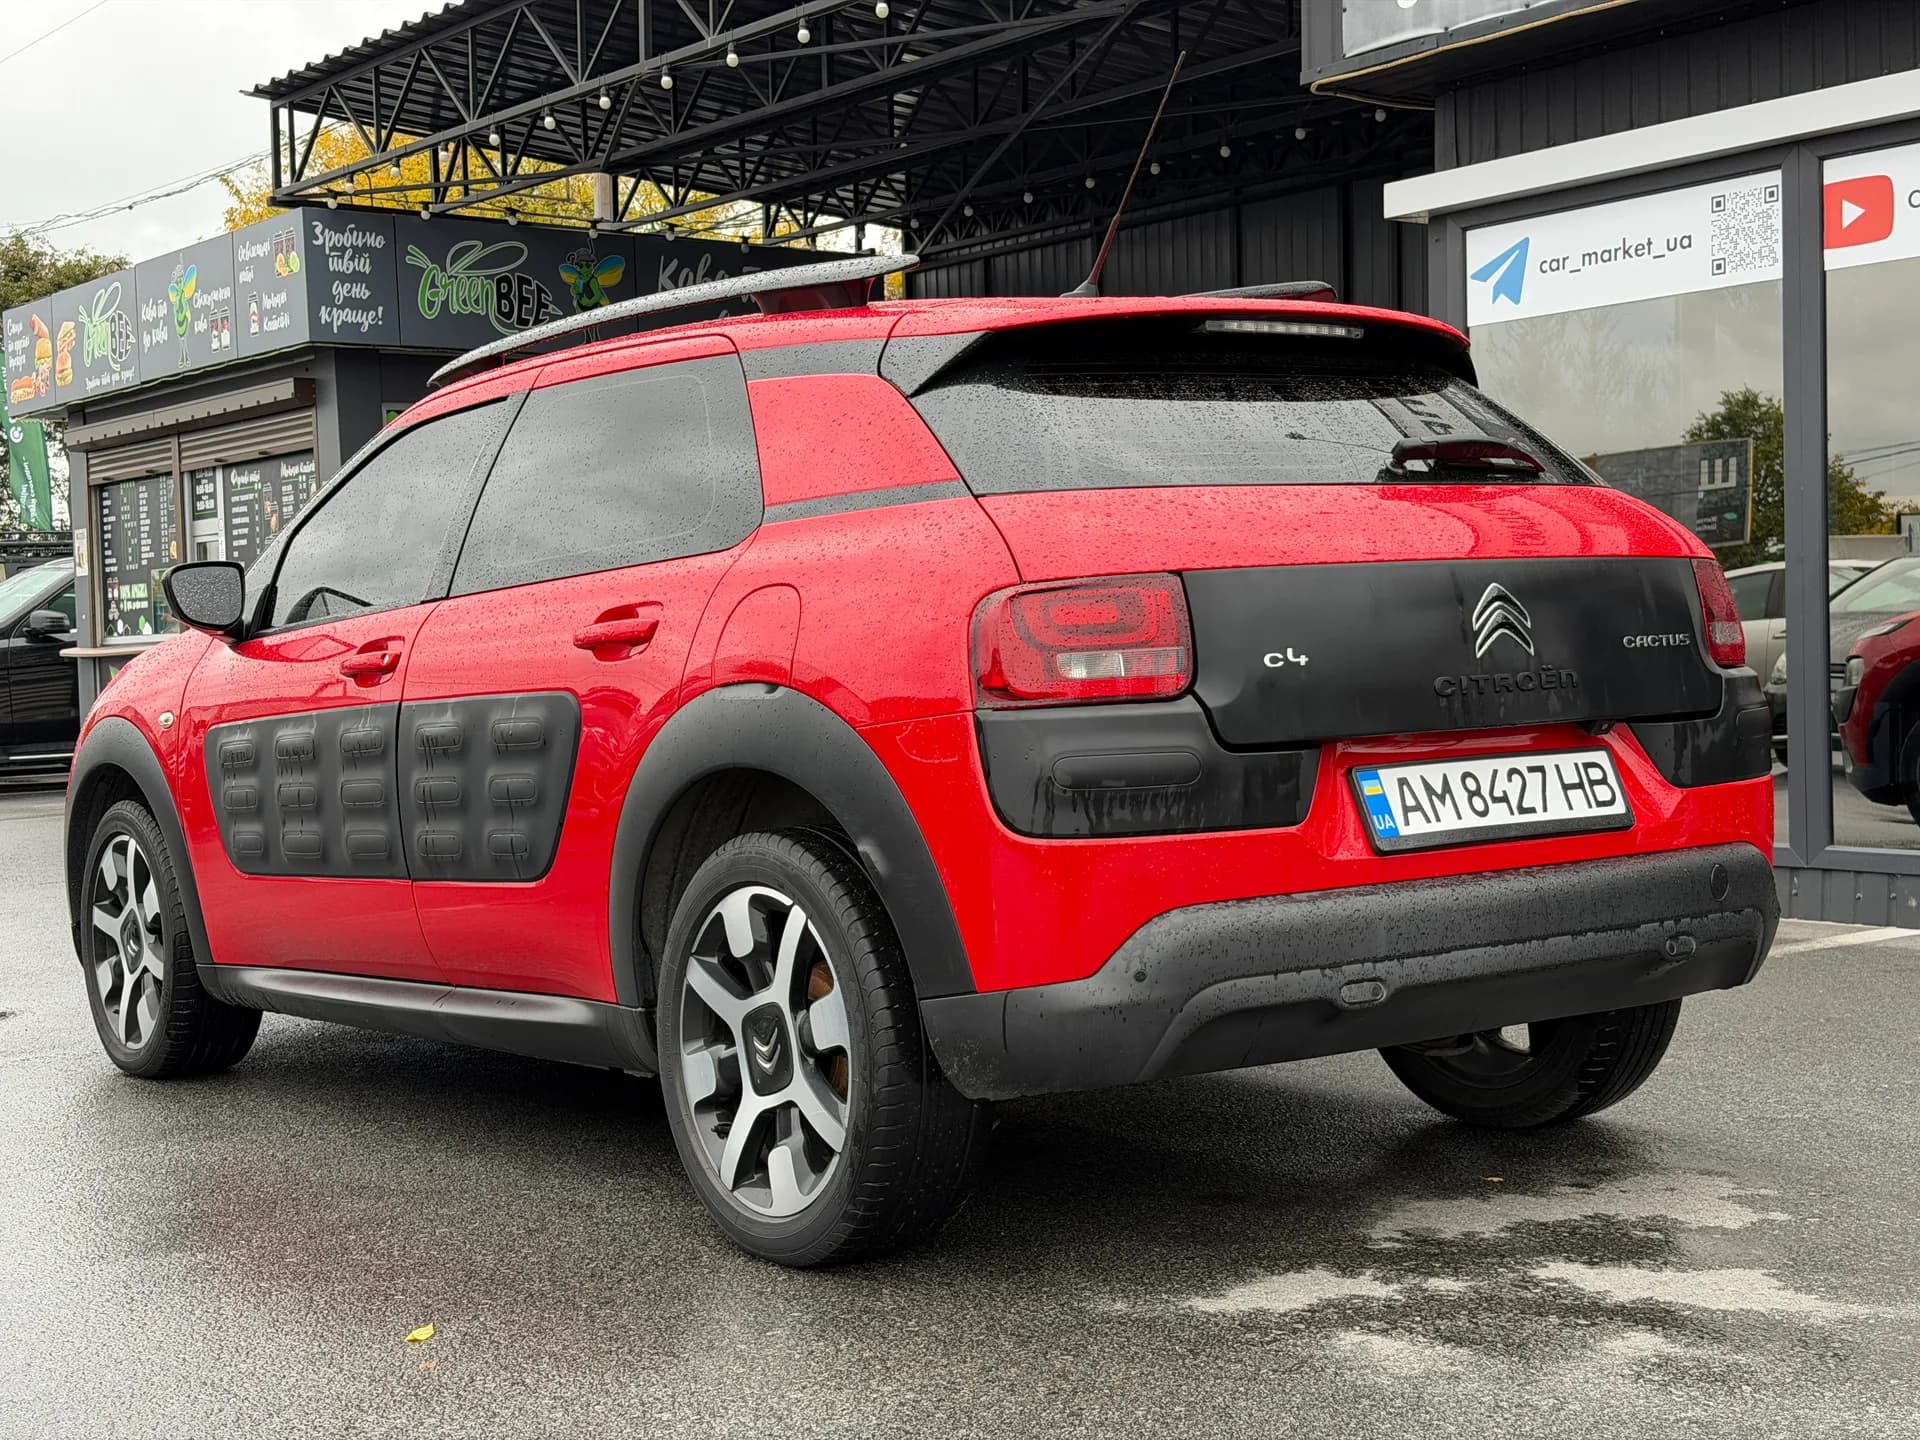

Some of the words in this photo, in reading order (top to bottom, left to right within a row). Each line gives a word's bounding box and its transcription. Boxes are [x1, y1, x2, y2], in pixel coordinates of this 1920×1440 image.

[312, 221, 386, 255] Зробимо
[328, 248, 373, 274] твій
[1539, 233, 1693, 275] car_market_ua
[331, 280, 372, 305] день
[318, 305, 384, 334] краще!
[1622, 633, 1691, 648] CACTUS
[1373, 814, 1397, 831] UA
